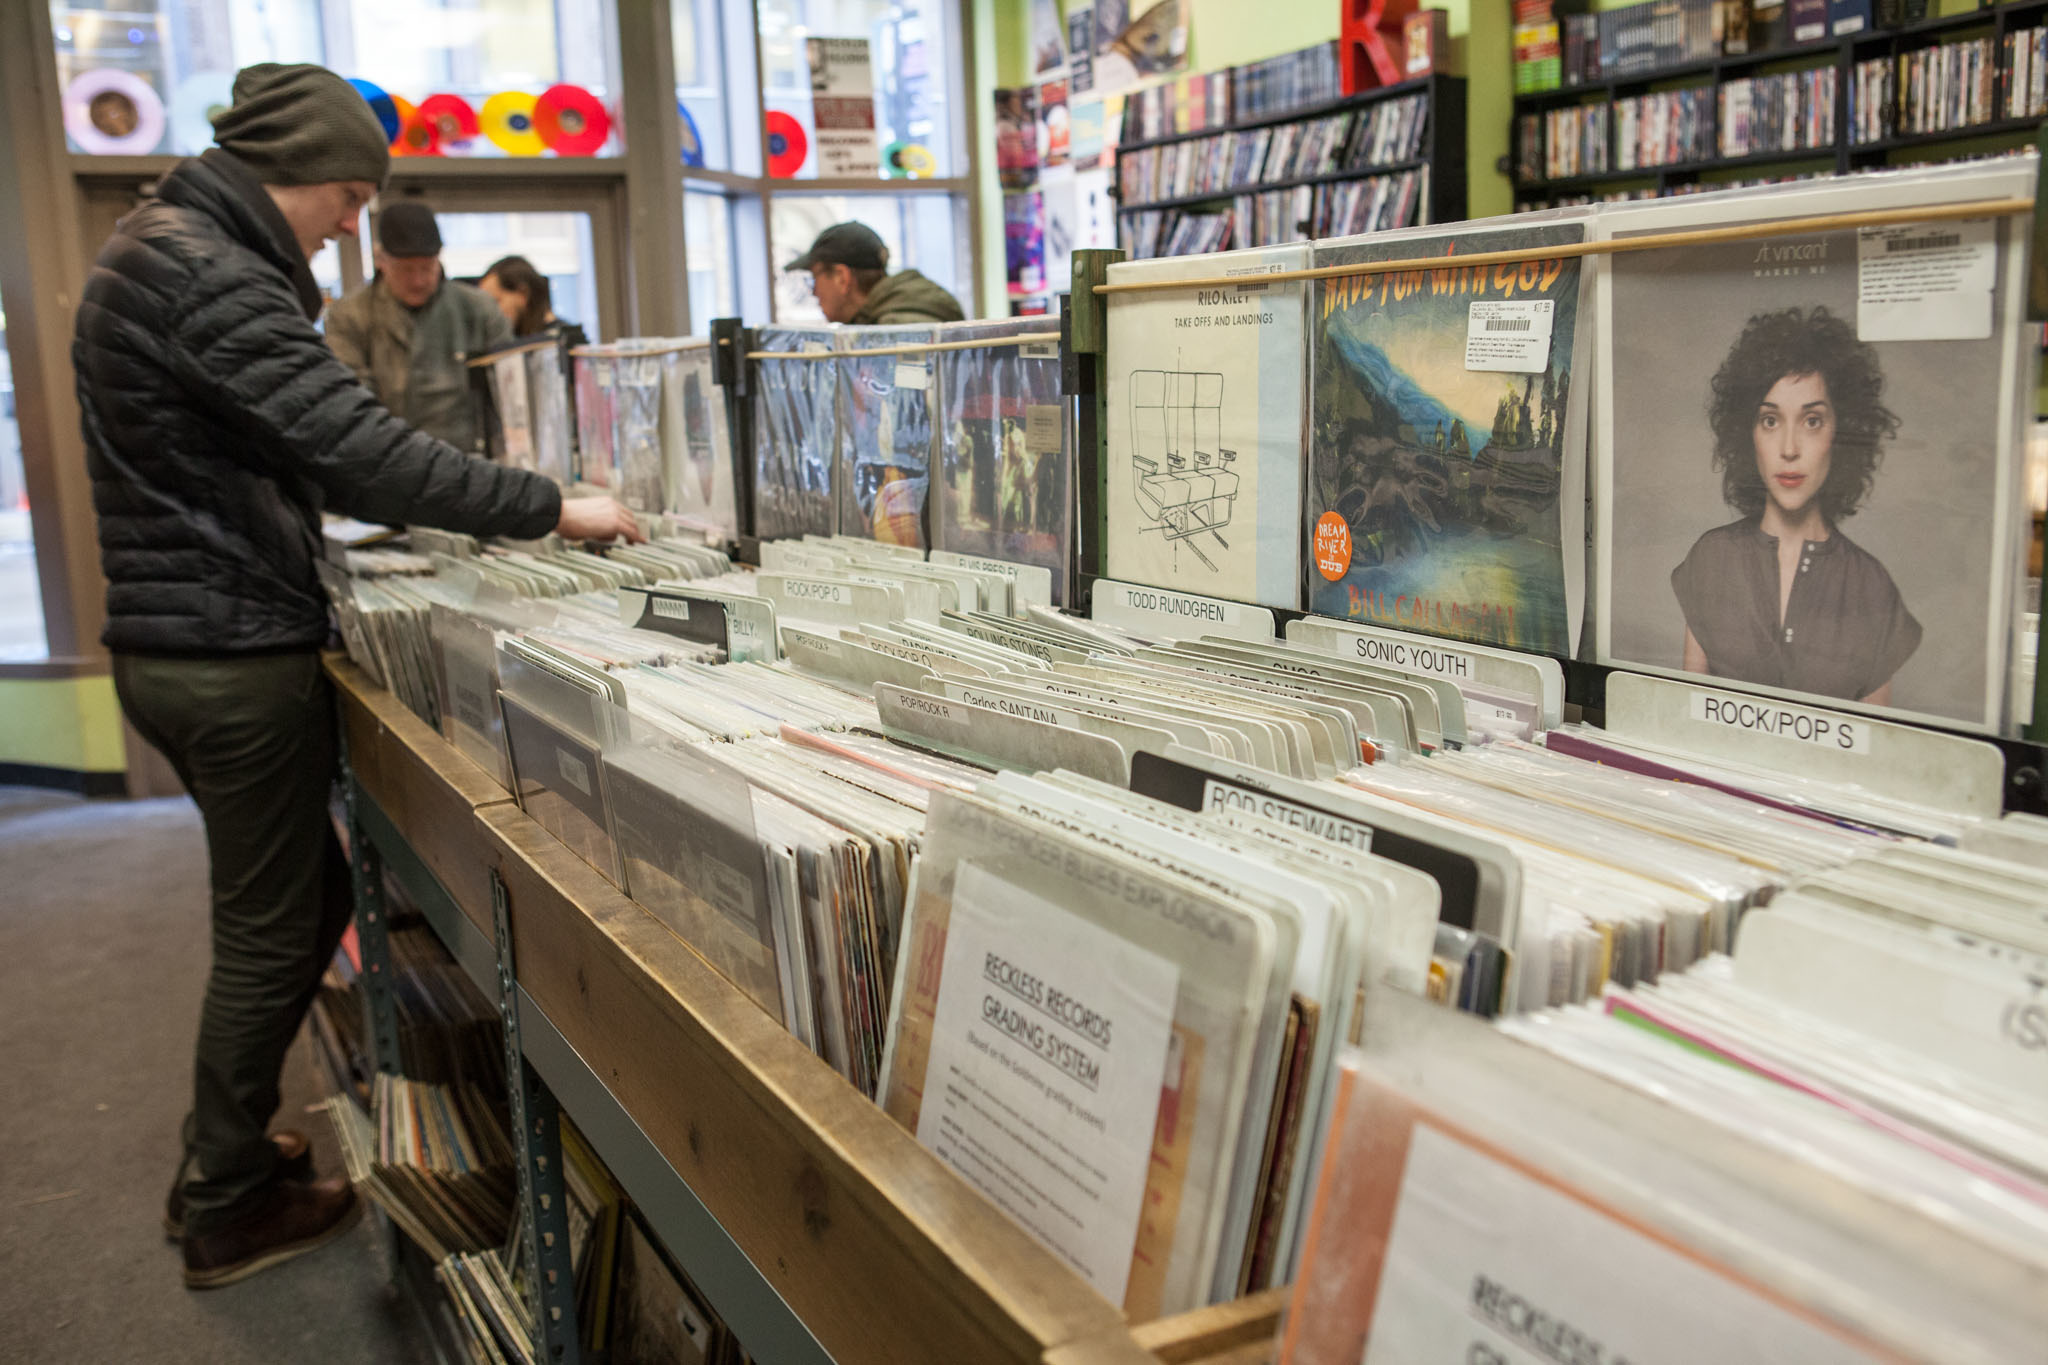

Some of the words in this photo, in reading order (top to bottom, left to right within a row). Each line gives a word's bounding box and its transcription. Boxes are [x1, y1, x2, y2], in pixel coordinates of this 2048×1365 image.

[1323, 264, 1373, 320] HAVE
[1380, 258, 1425, 306] FUN
[1431, 241, 1488, 297] WITH
[1493, 257, 1563, 298] GOD
[1198, 290, 1220, 306] RILO
[1175, 318, 1192, 328] TAKE
[1194, 316, 1211, 328] OFFS
[1214, 315, 1230, 326] AND
[1232, 313, 1273, 326] LANDINGS
[1317, 538, 1347, 556] RIVER
[1319, 523, 1347, 544] DREAM
[1320, 559, 1343, 573] DUB
[1127, 591, 1157, 610] TODD
[1159, 596, 1225, 622] RUNDGREN
[1347, 584, 1393, 621] BILL
[1010, 638, 1052, 663] STONES
[1356, 638, 1406, 665] SONIC
[1410, 647, 1468, 678] YOUTH
[900, 695, 941, 715] POP/ROCK
[963, 691, 996, 711] Carlos
[1000, 700, 1058, 725] SANTANA
[1705, 697, 1830, 742] ROCK/POP
[1837, 723, 1855, 749] S
[1212, 786, 1256, 813] ROD
[1264, 801, 1372, 852] STEWART
[984, 951, 1045, 1006] RECKLESS
[1047, 986, 1113, 1047] RECORDS
[982, 994, 1045, 1050] GRADING
[1047, 1033, 1101, 1088] SYSTEM
